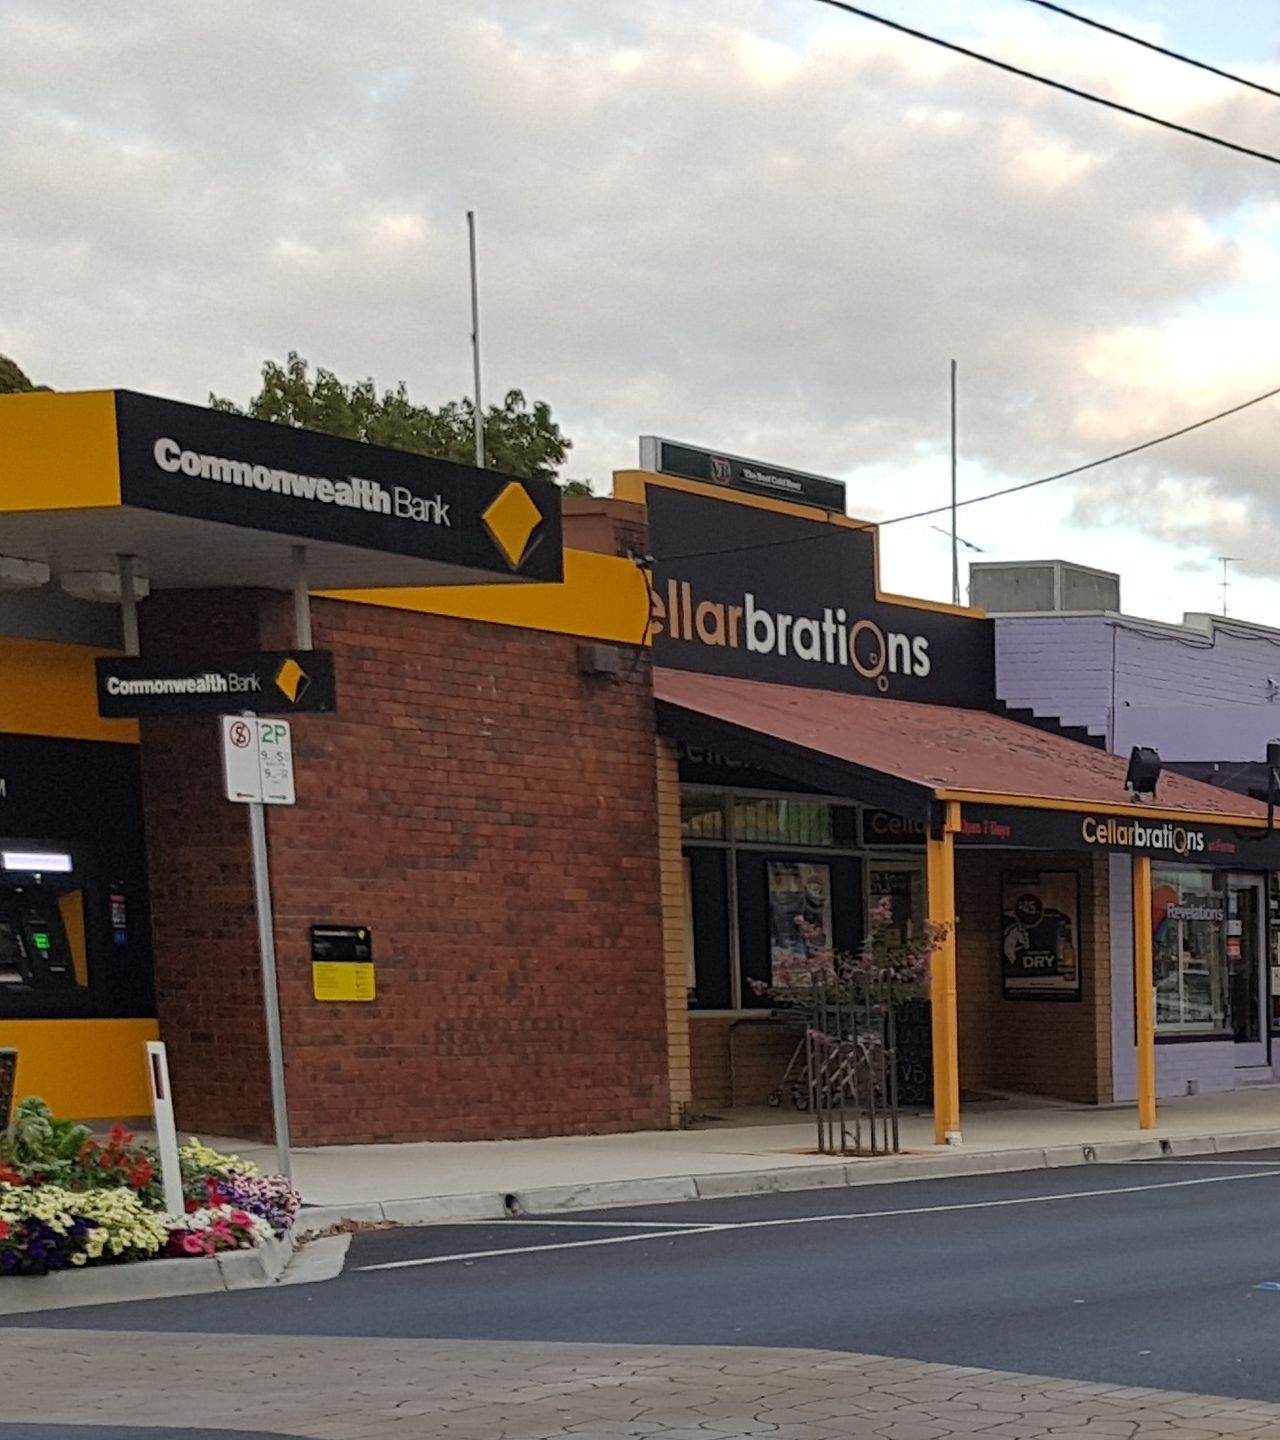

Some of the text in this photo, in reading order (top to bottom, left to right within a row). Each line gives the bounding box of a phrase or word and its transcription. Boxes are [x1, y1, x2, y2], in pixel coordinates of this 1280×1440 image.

[651, 579, 931, 680] ellarbrations
[261, 724, 287, 745] 2P
[1022, 955, 1055, 969] DRY
